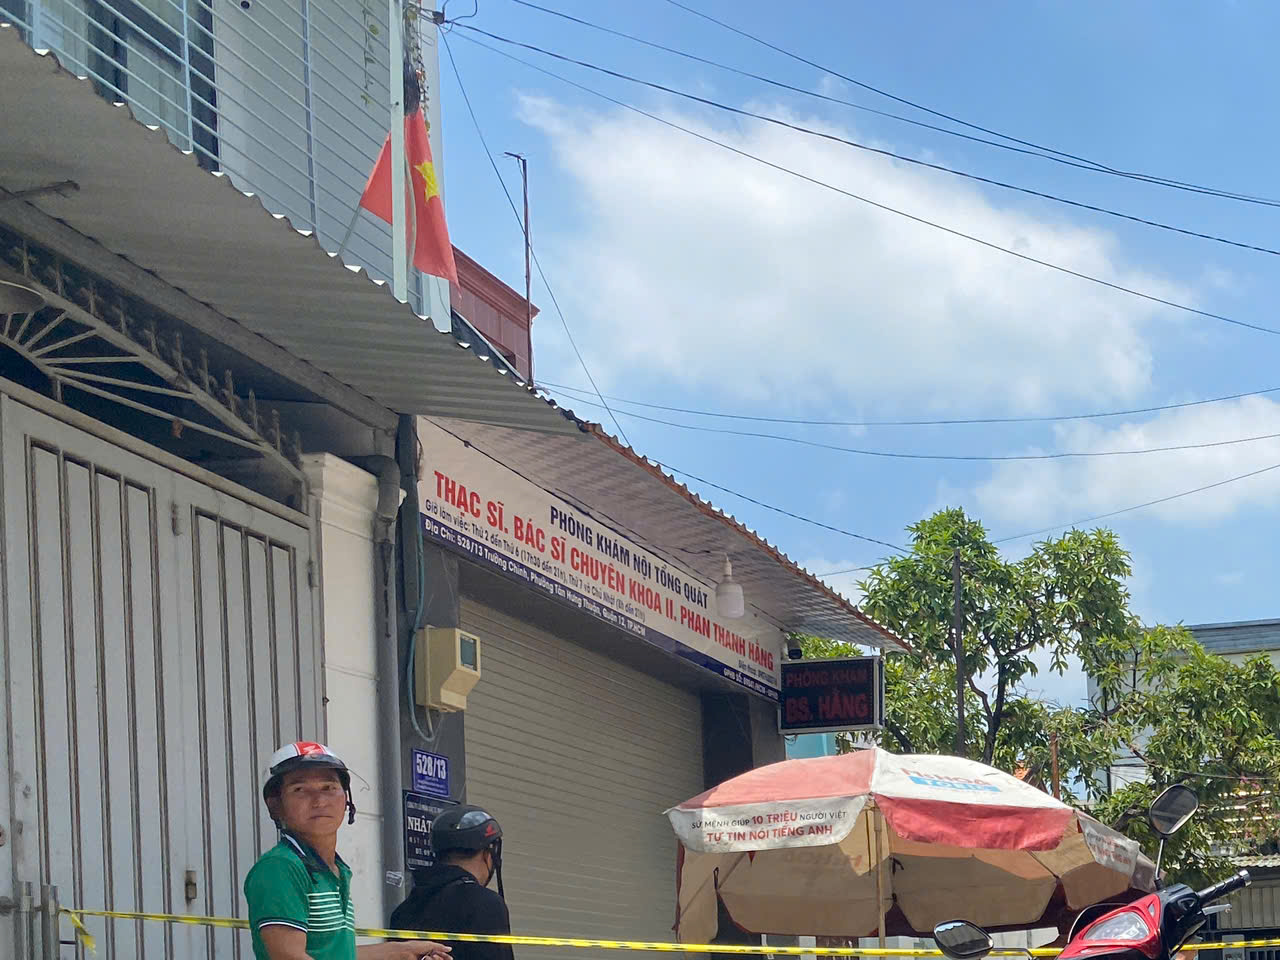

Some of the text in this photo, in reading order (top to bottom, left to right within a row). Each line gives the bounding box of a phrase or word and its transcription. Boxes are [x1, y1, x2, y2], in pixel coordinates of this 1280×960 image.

[457, 533, 483, 556] 528/13
[550, 505, 593, 547] PHÒNG
[596, 532, 630, 567] KHÁM
[633, 553, 652, 580] NỘI
[434, 470, 480, 518] THẠC
[514, 515, 545, 552] BÁC
[551, 536, 566, 565] SĨ
[570, 547, 625, 595] CHUYÊN
[629, 578, 662, 614] KHOA
[680, 605, 711, 640] PHAN
[713, 622, 746, 657] THANH
[415, 753, 447, 780] 528/13
[752, 815, 764, 825] 10
[727, 831, 746, 842] TIN
[807, 824, 833, 834] ANH
